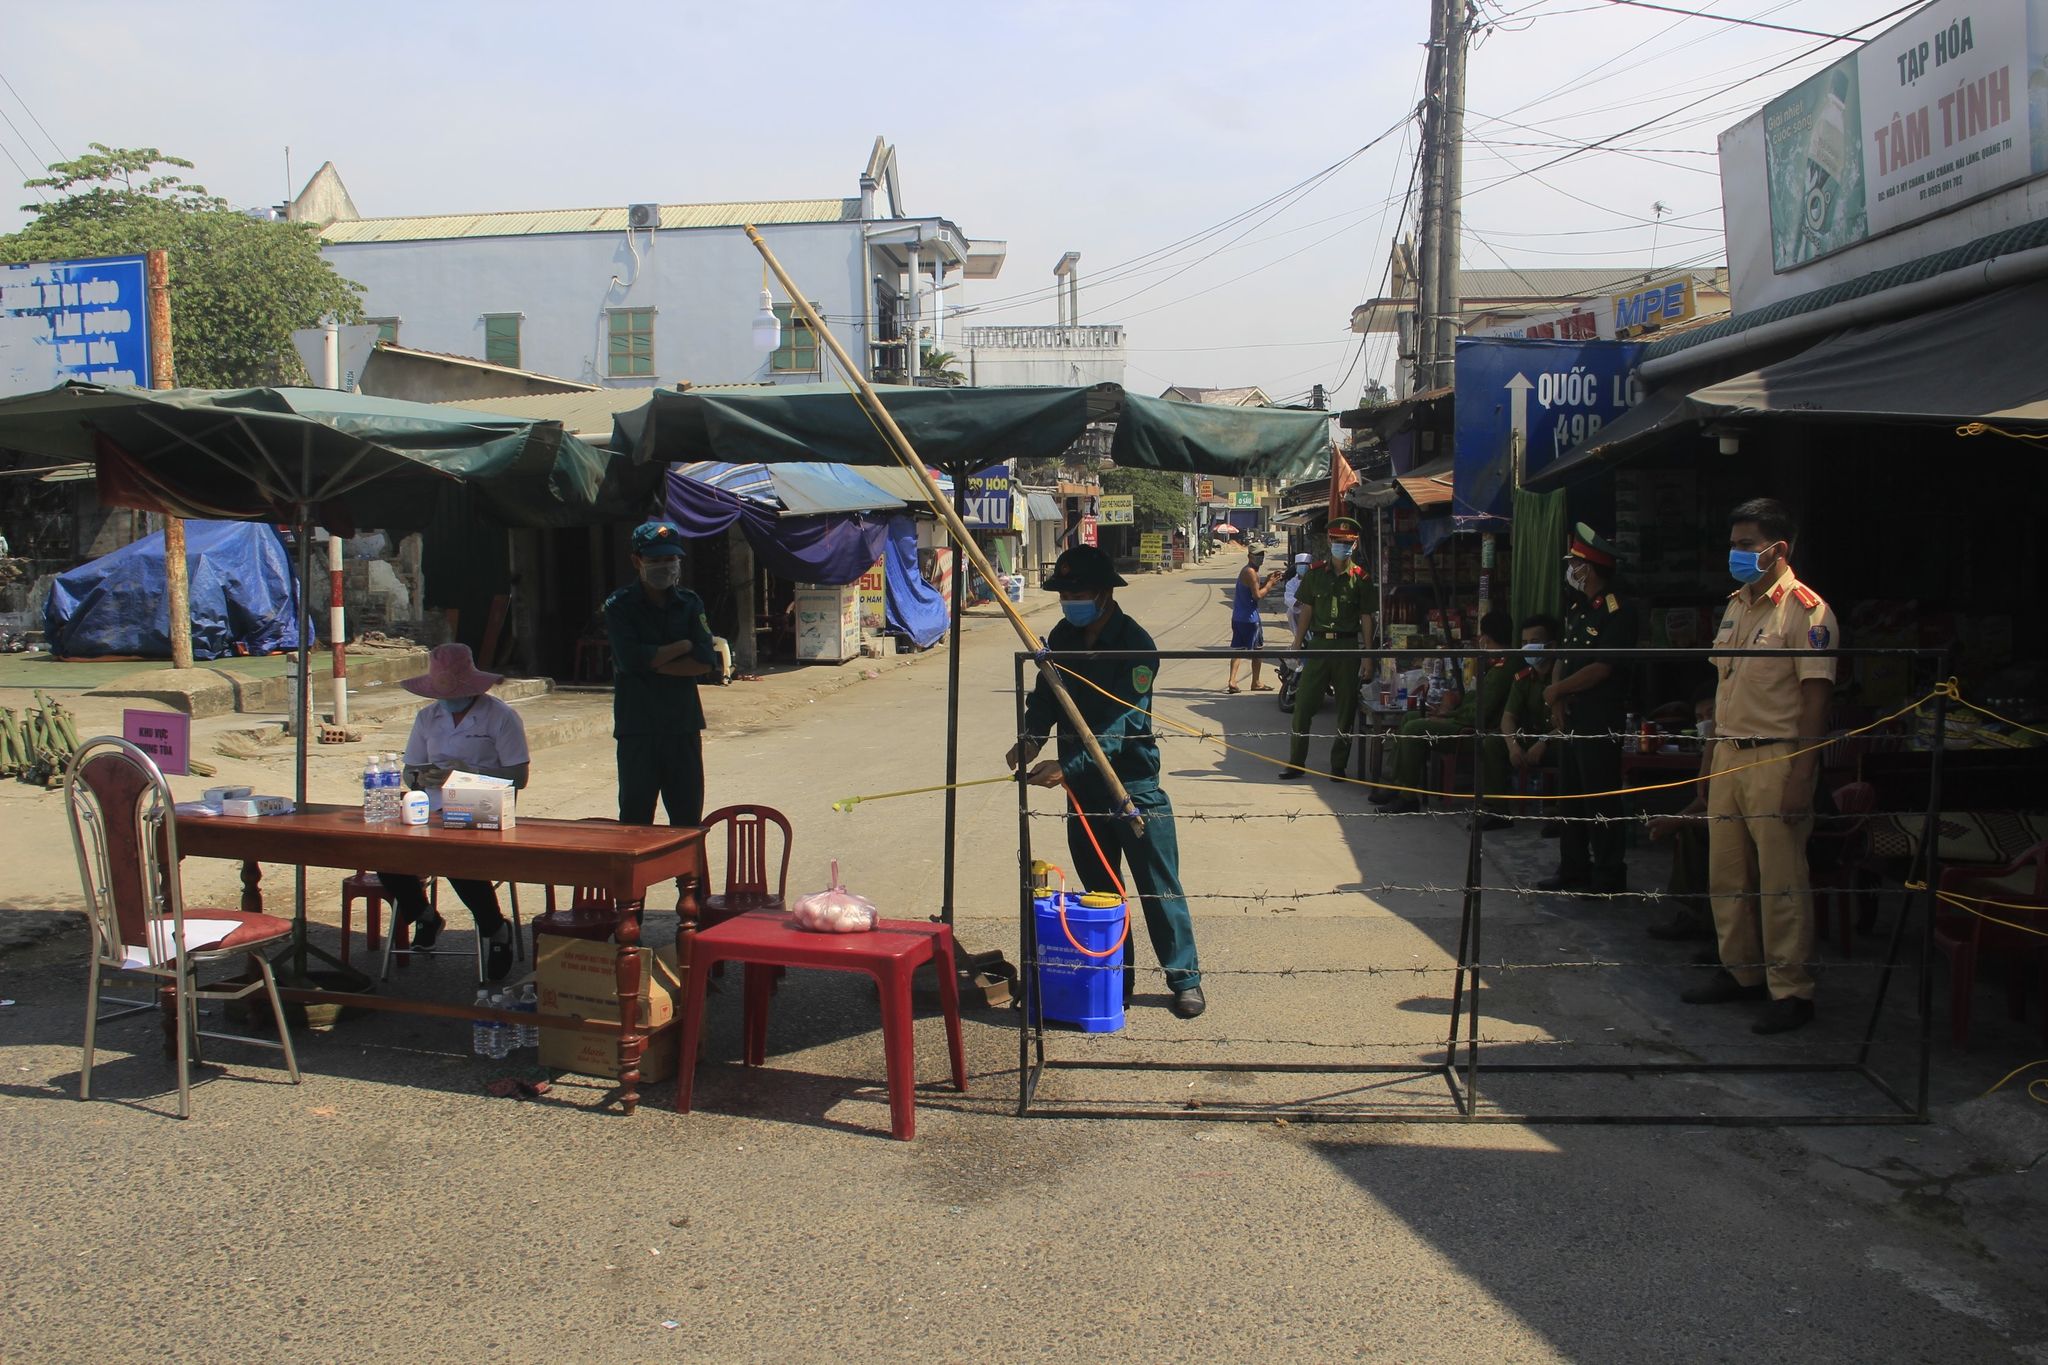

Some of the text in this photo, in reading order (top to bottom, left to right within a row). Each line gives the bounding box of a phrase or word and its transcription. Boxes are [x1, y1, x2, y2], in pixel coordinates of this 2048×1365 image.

[1897, 16, 1974, 88] TẠP HÓA
[1874, 66, 2011, 177] TÂM TÍNH
[1615, 282, 1684, 329] MPE
[1537, 365, 1598, 410] QUỐC
[985, 475, 1008, 491] HÓA
[965, 492, 1007, 524] XÍU
[139, 727, 153, 738] KHU
